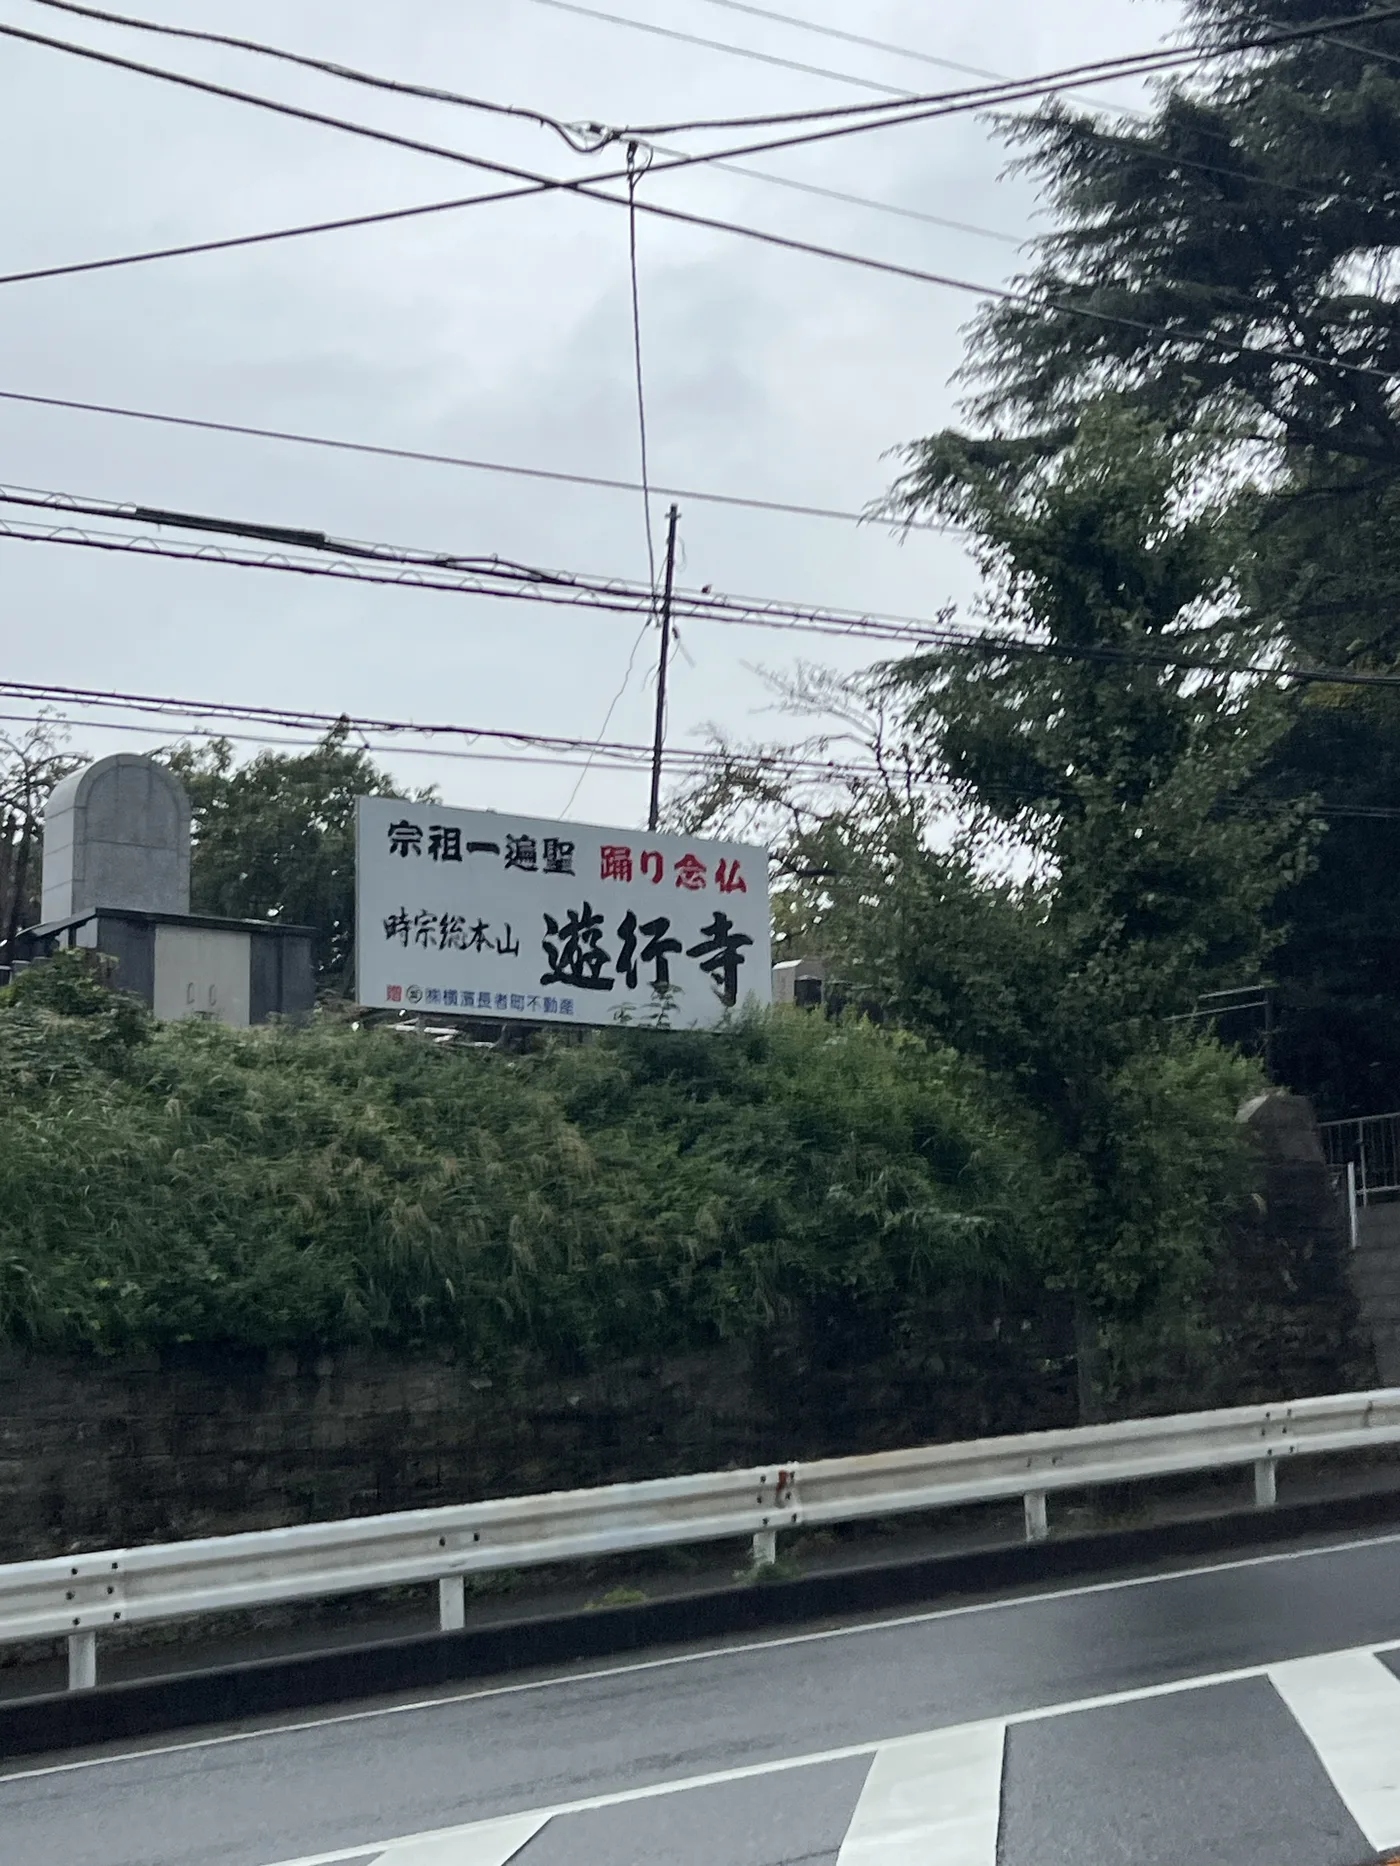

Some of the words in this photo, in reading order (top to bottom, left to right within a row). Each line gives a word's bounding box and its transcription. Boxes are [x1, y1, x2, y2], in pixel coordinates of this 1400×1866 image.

[387, 819, 576, 877] 宗祖一遍聖
[600, 845, 747, 893] 踊り念仏
[383, 906, 519, 957] 時宗総本山
[540, 901, 754, 1008] 遊行寺
